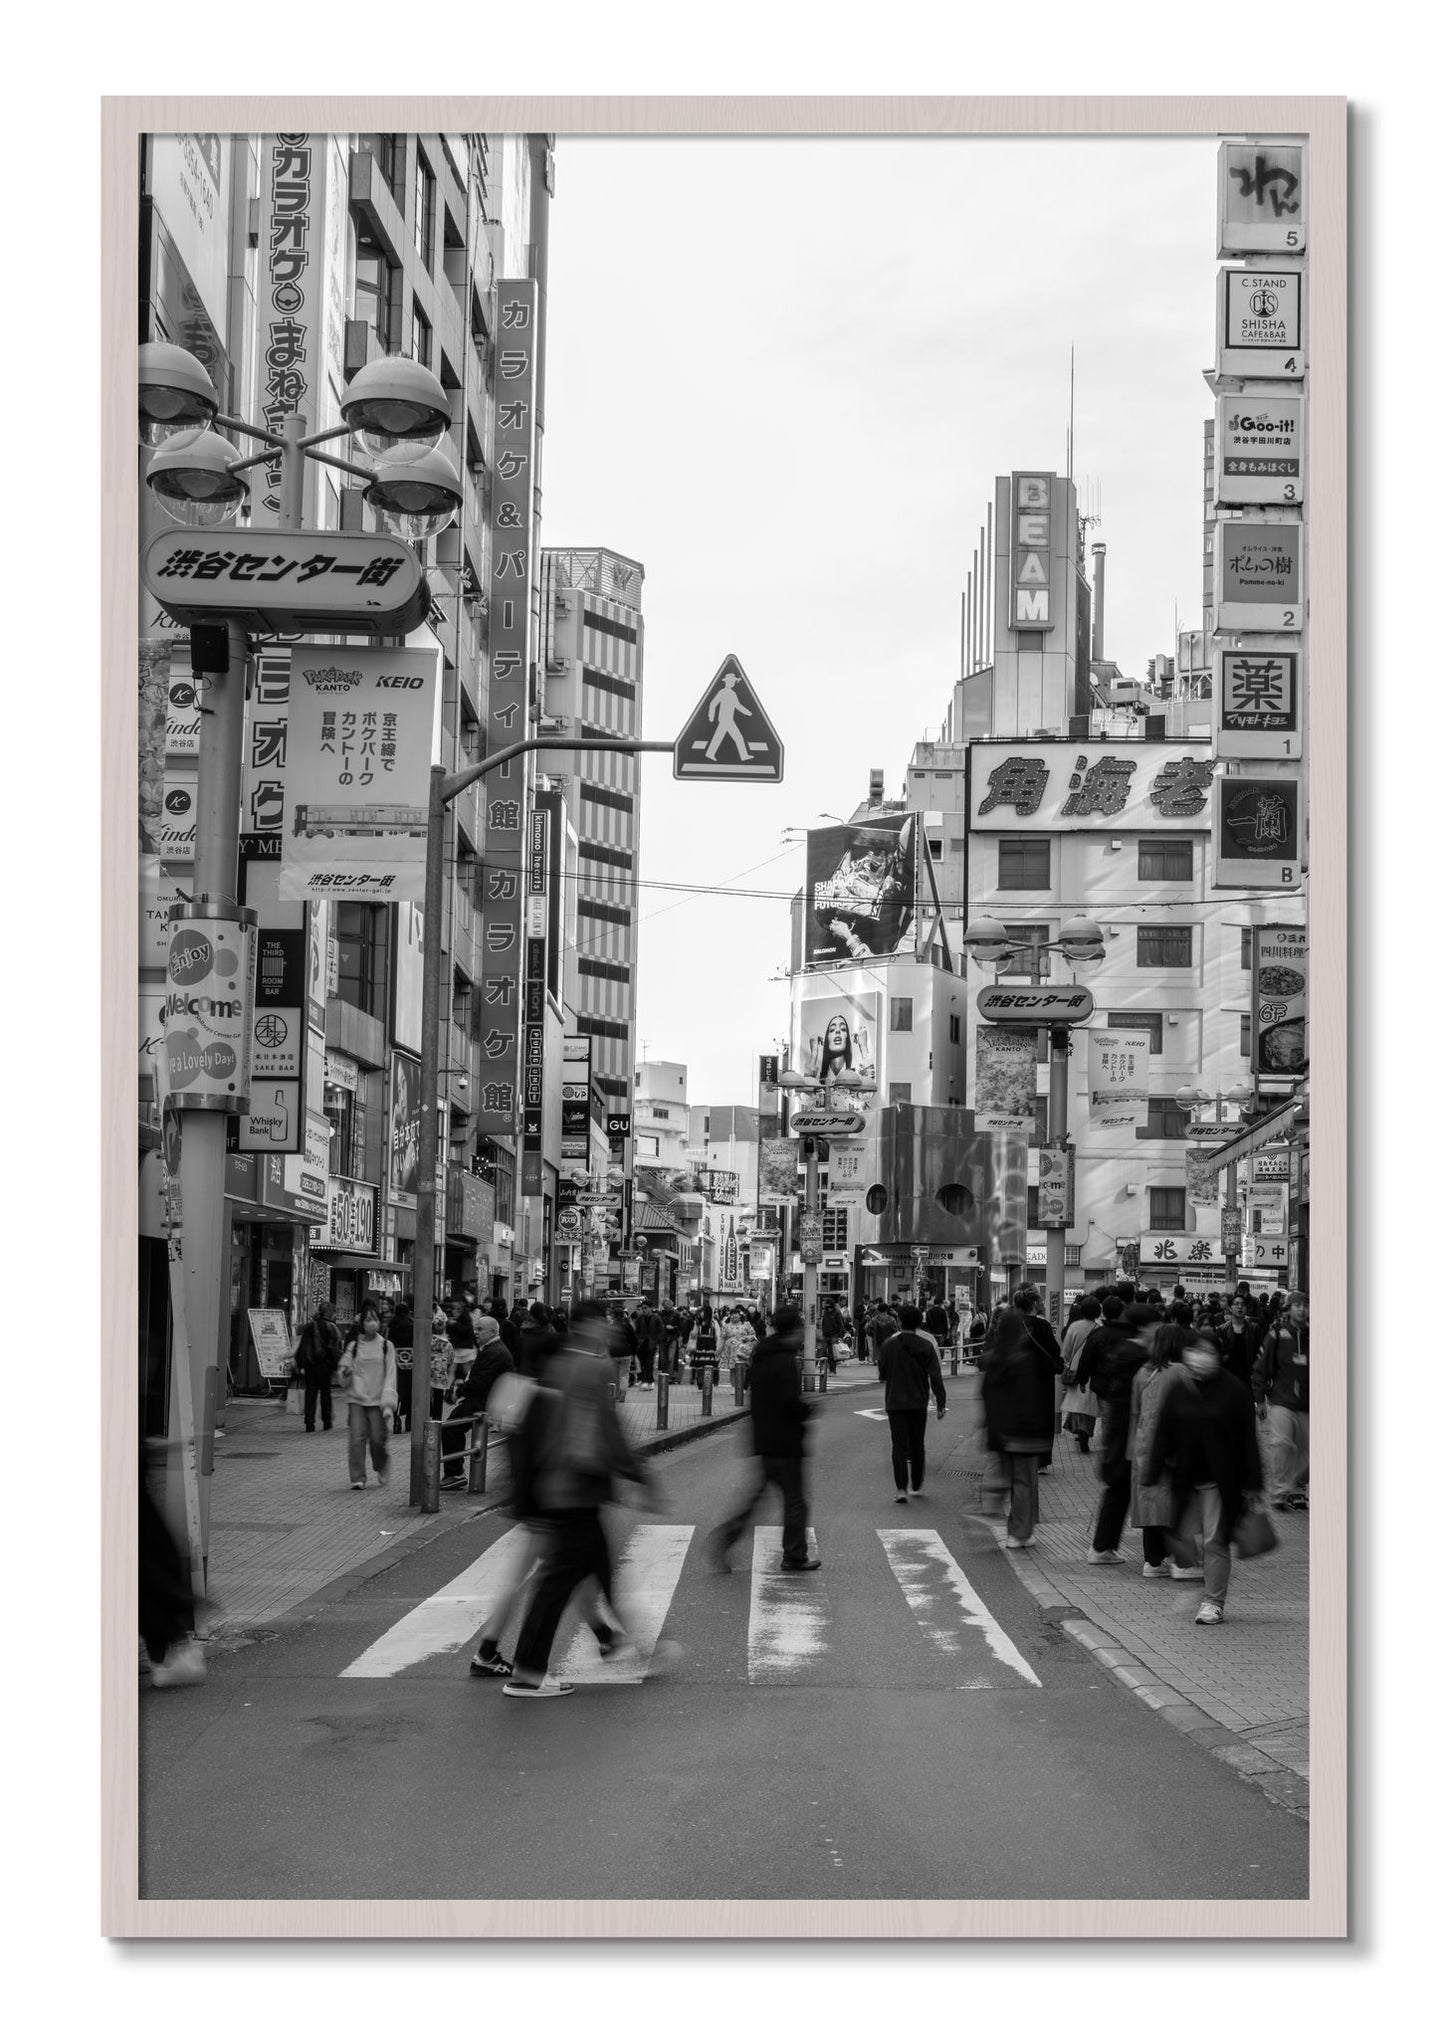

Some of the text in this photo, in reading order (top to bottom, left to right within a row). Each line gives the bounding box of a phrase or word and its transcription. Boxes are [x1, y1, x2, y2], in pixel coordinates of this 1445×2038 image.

[270, 146, 311, 283] カラオケ
[1286, 231, 1298, 246] 5
[1242, 279, 1286, 288] C.STAND
[1242, 319, 1286, 329] SHISHA
[1242, 330, 1286, 338] CAFE&BAR
[1285, 357, 1296, 372] 4
[1240, 416, 1294, 432] Goo-it!
[1228, 461, 1295, 473] 全身もみほぐし
[1284, 484, 1295, 500] 3
[1017, 478, 1048, 621] BEAM
[157, 549, 405, 587] 渋谷センター街
[1283, 611, 1295, 626] 2
[316, 684, 350, 692] KANTO
[375, 675, 424, 689] KEIO
[1232, 659, 1283, 710] 薬
[1227, 713, 1288, 727] マツモトキヨシ
[320, 711, 336, 754] 冒険へ
[338, 711, 356, 786] カントーの
[380, 712, 397, 772] 京王線で
[1283, 739, 1290, 754] 1
[978, 755, 1217, 816] 角海老
[166, 846, 191, 854] 渋谷店
[532, 815, 544, 889] kimono hearts
[307, 873, 396, 887] 渋谷センター街
[1282, 867, 1293, 882] B
[814, 877, 853, 892] SHAPING
[1261, 946, 1305, 958] 四川料理
[169, 943, 210, 978] Enjoy
[482, 871, 517, 1112] カラオケ館
[166, 993, 242, 1018] Welcome
[984, 994, 1087, 1008] 渋谷センター街
[1259, 1003, 1287, 1023] 6F
[183, 1051, 213, 1070] Lovely
[215, 1052, 235, 1066] Day!
[250, 1116, 283, 1127] Whisky
[609, 1120, 629, 1131] GU
[249, 1126, 270, 1134] Bank
[354, 1196, 372, 1243] 190
[1154, 1239, 1213, 1261] 兆楽
[727, 1237, 736, 1280] BEER
